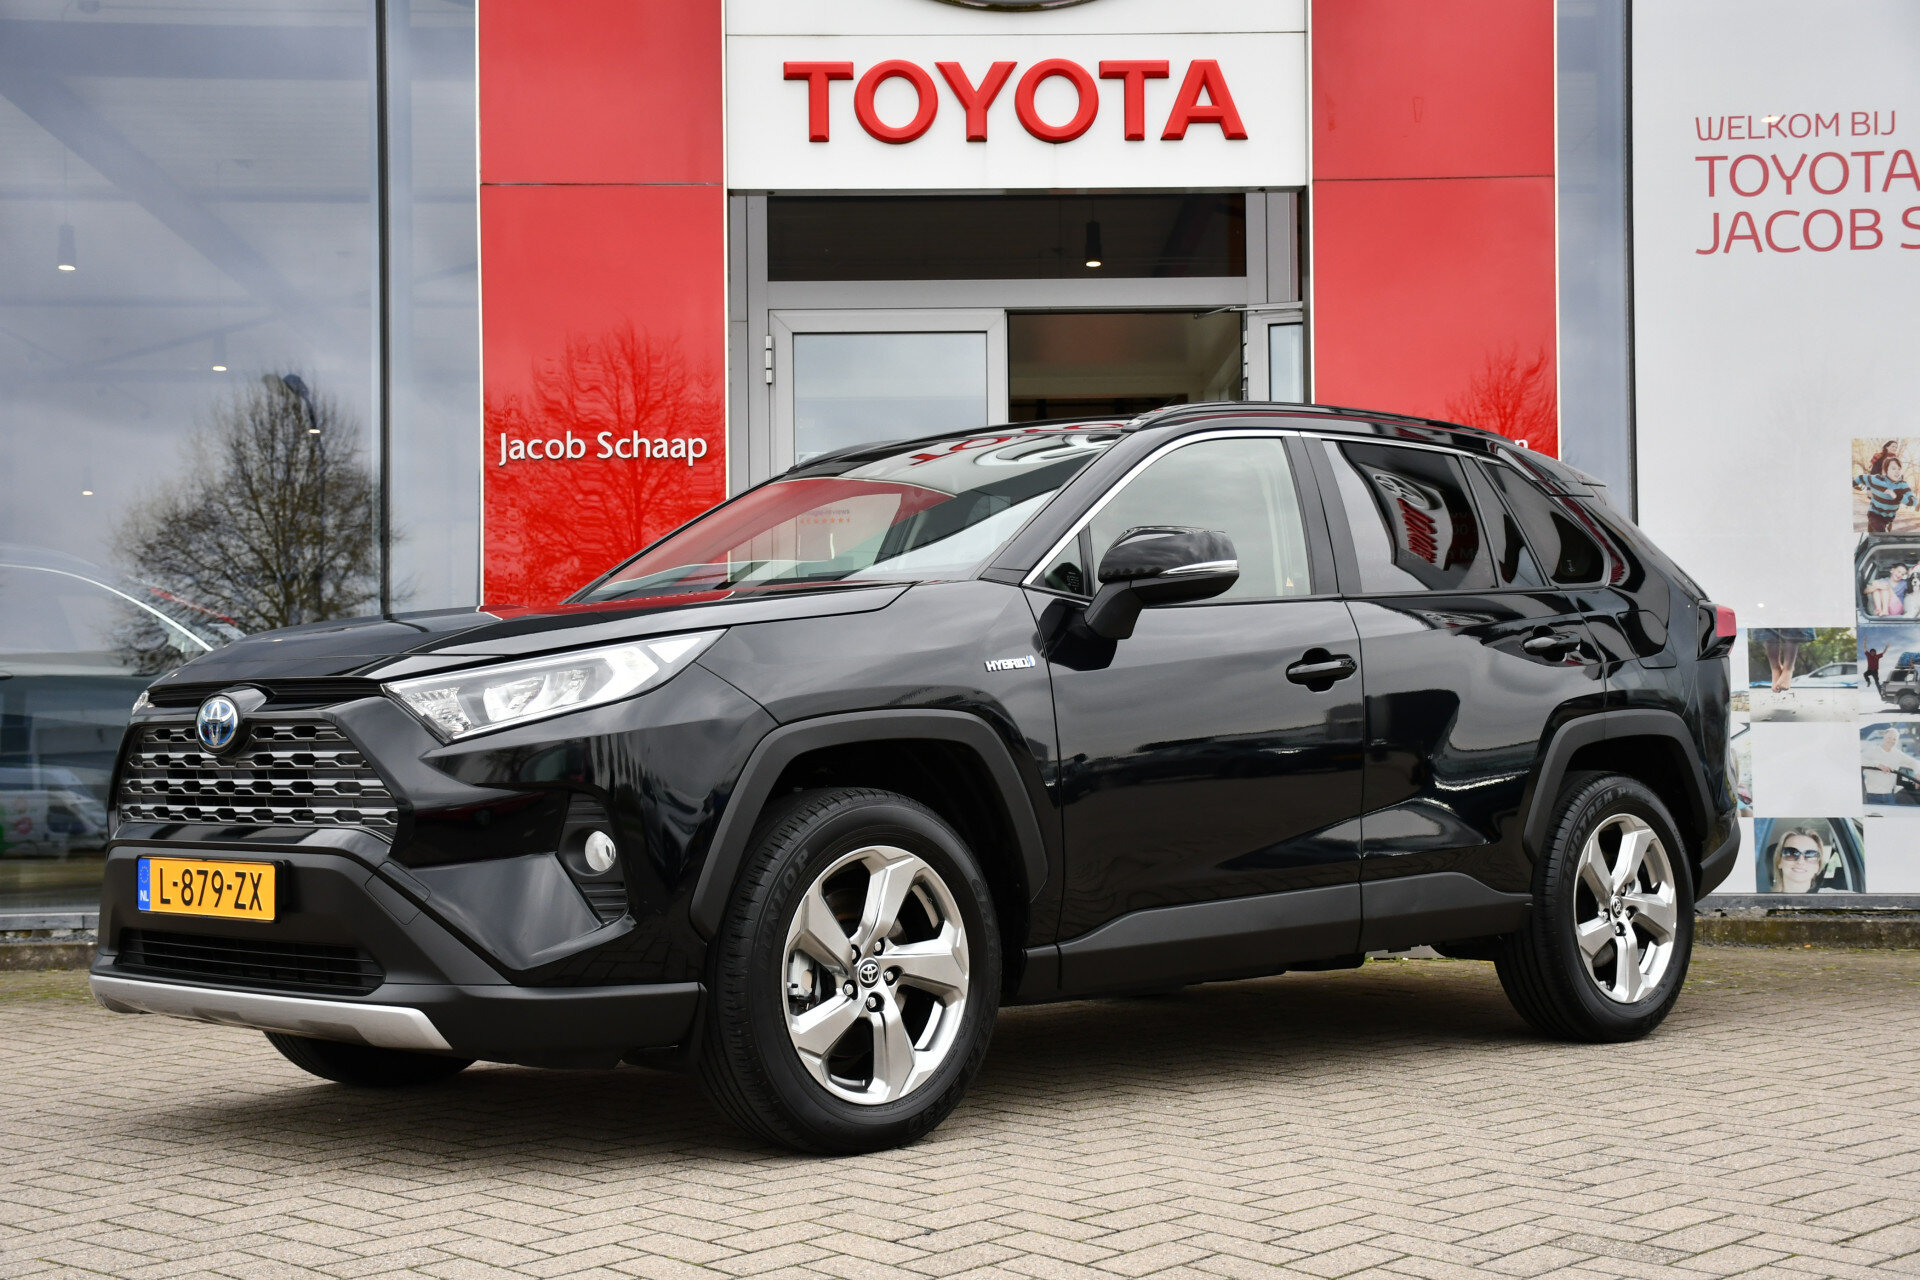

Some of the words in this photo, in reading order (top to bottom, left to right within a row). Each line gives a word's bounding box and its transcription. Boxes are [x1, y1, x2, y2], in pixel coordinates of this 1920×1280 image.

[783, 57, 1248, 144] TOYOTA
[1695, 112, 1840, 141] WELKOM
[1850, 110, 1896, 137] BIJ
[1695, 149, 1920, 197] TOYOTA
[1695, 208, 1884, 255] JACOB
[499, 430, 586, 467] Jacob
[596, 430, 707, 467] Schaap
[985, 656, 1031, 672] HYBRID
[140, 889, 150, 902] NL
[160, 867, 263, 911] L-879-ZX
